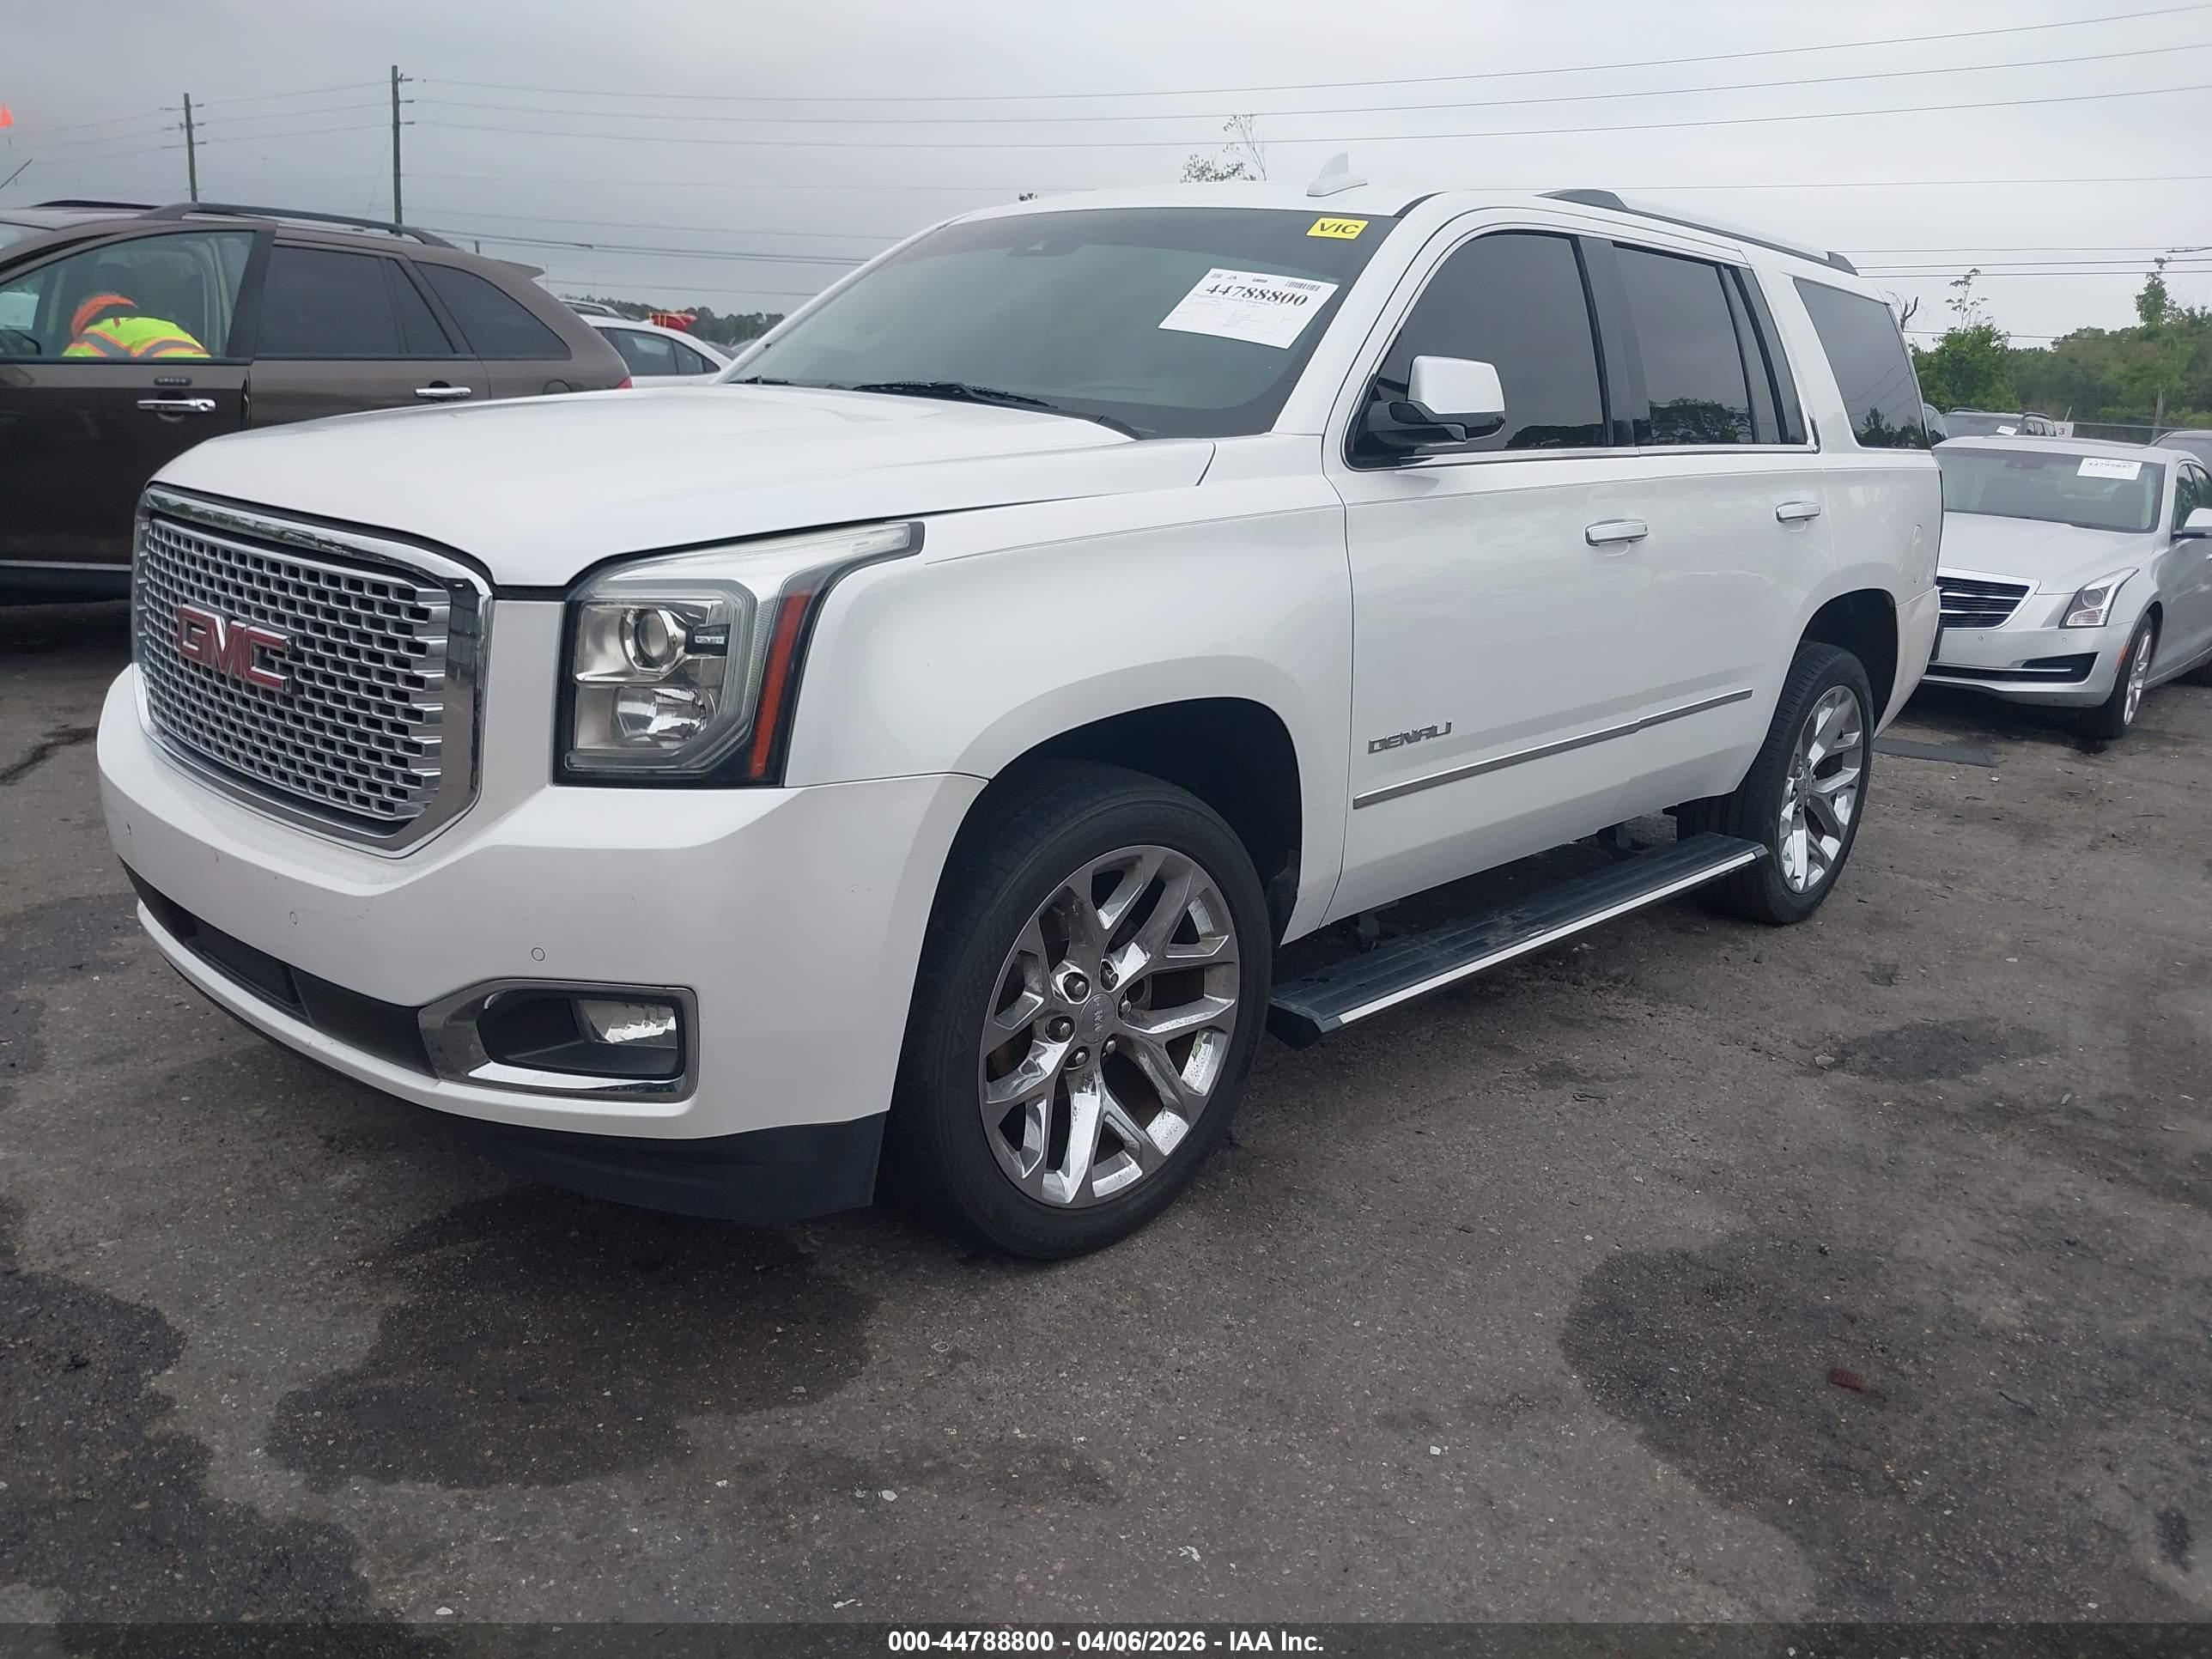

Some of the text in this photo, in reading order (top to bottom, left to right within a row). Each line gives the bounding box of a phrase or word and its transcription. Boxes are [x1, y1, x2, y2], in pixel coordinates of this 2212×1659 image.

[1320, 222, 1359, 234] VIC
[1206, 283, 1309, 307] 44788800
[2057, 427, 2066, 435] 3
[177, 603, 291, 694] GMC
[1367, 720, 1452, 754] DENALI
